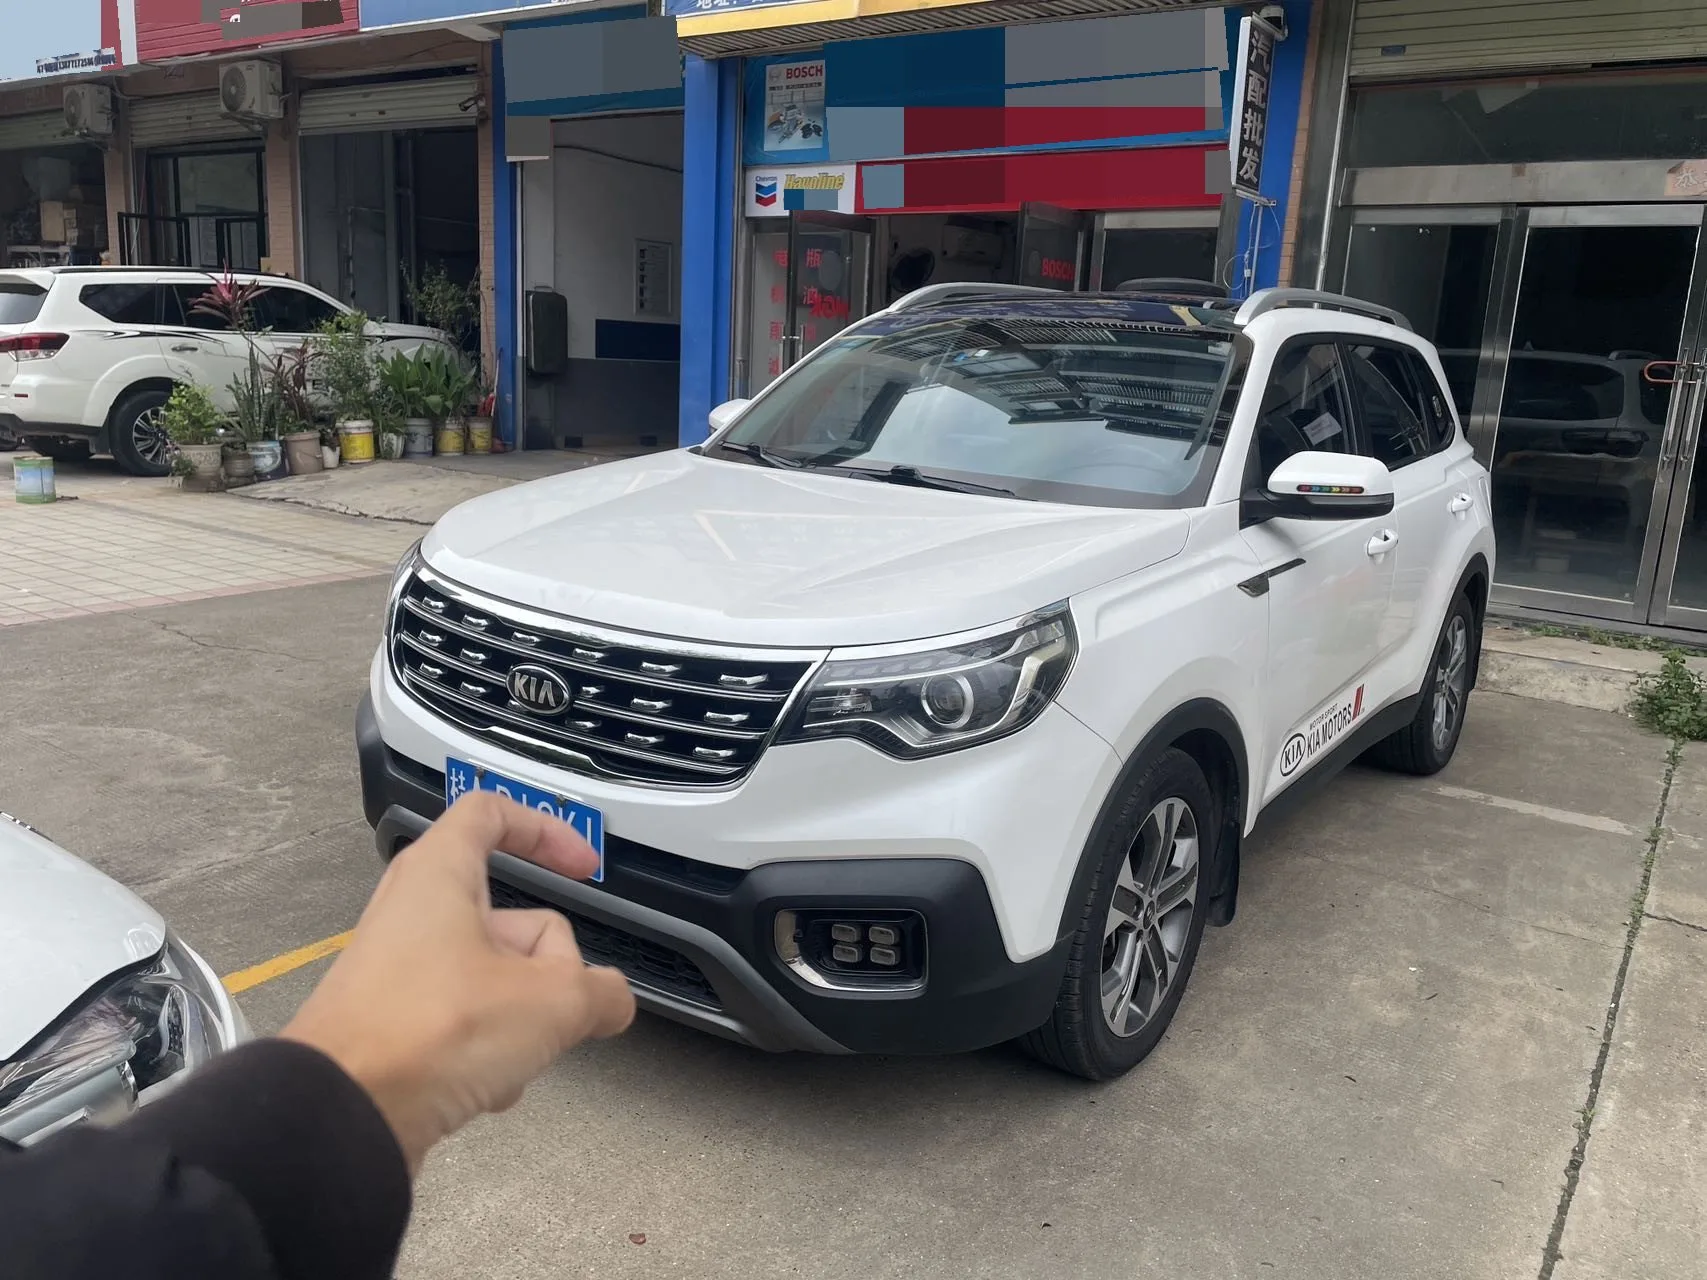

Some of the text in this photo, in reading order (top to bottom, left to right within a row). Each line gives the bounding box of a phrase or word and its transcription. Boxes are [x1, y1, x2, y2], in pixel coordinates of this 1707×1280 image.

[786, 65, 823, 79] BOSCH
[1239, 30, 1271, 184] 汽配批发
[514, 672, 556, 707] KIA
[1307, 703, 1352, 758] KIA MOTORS
